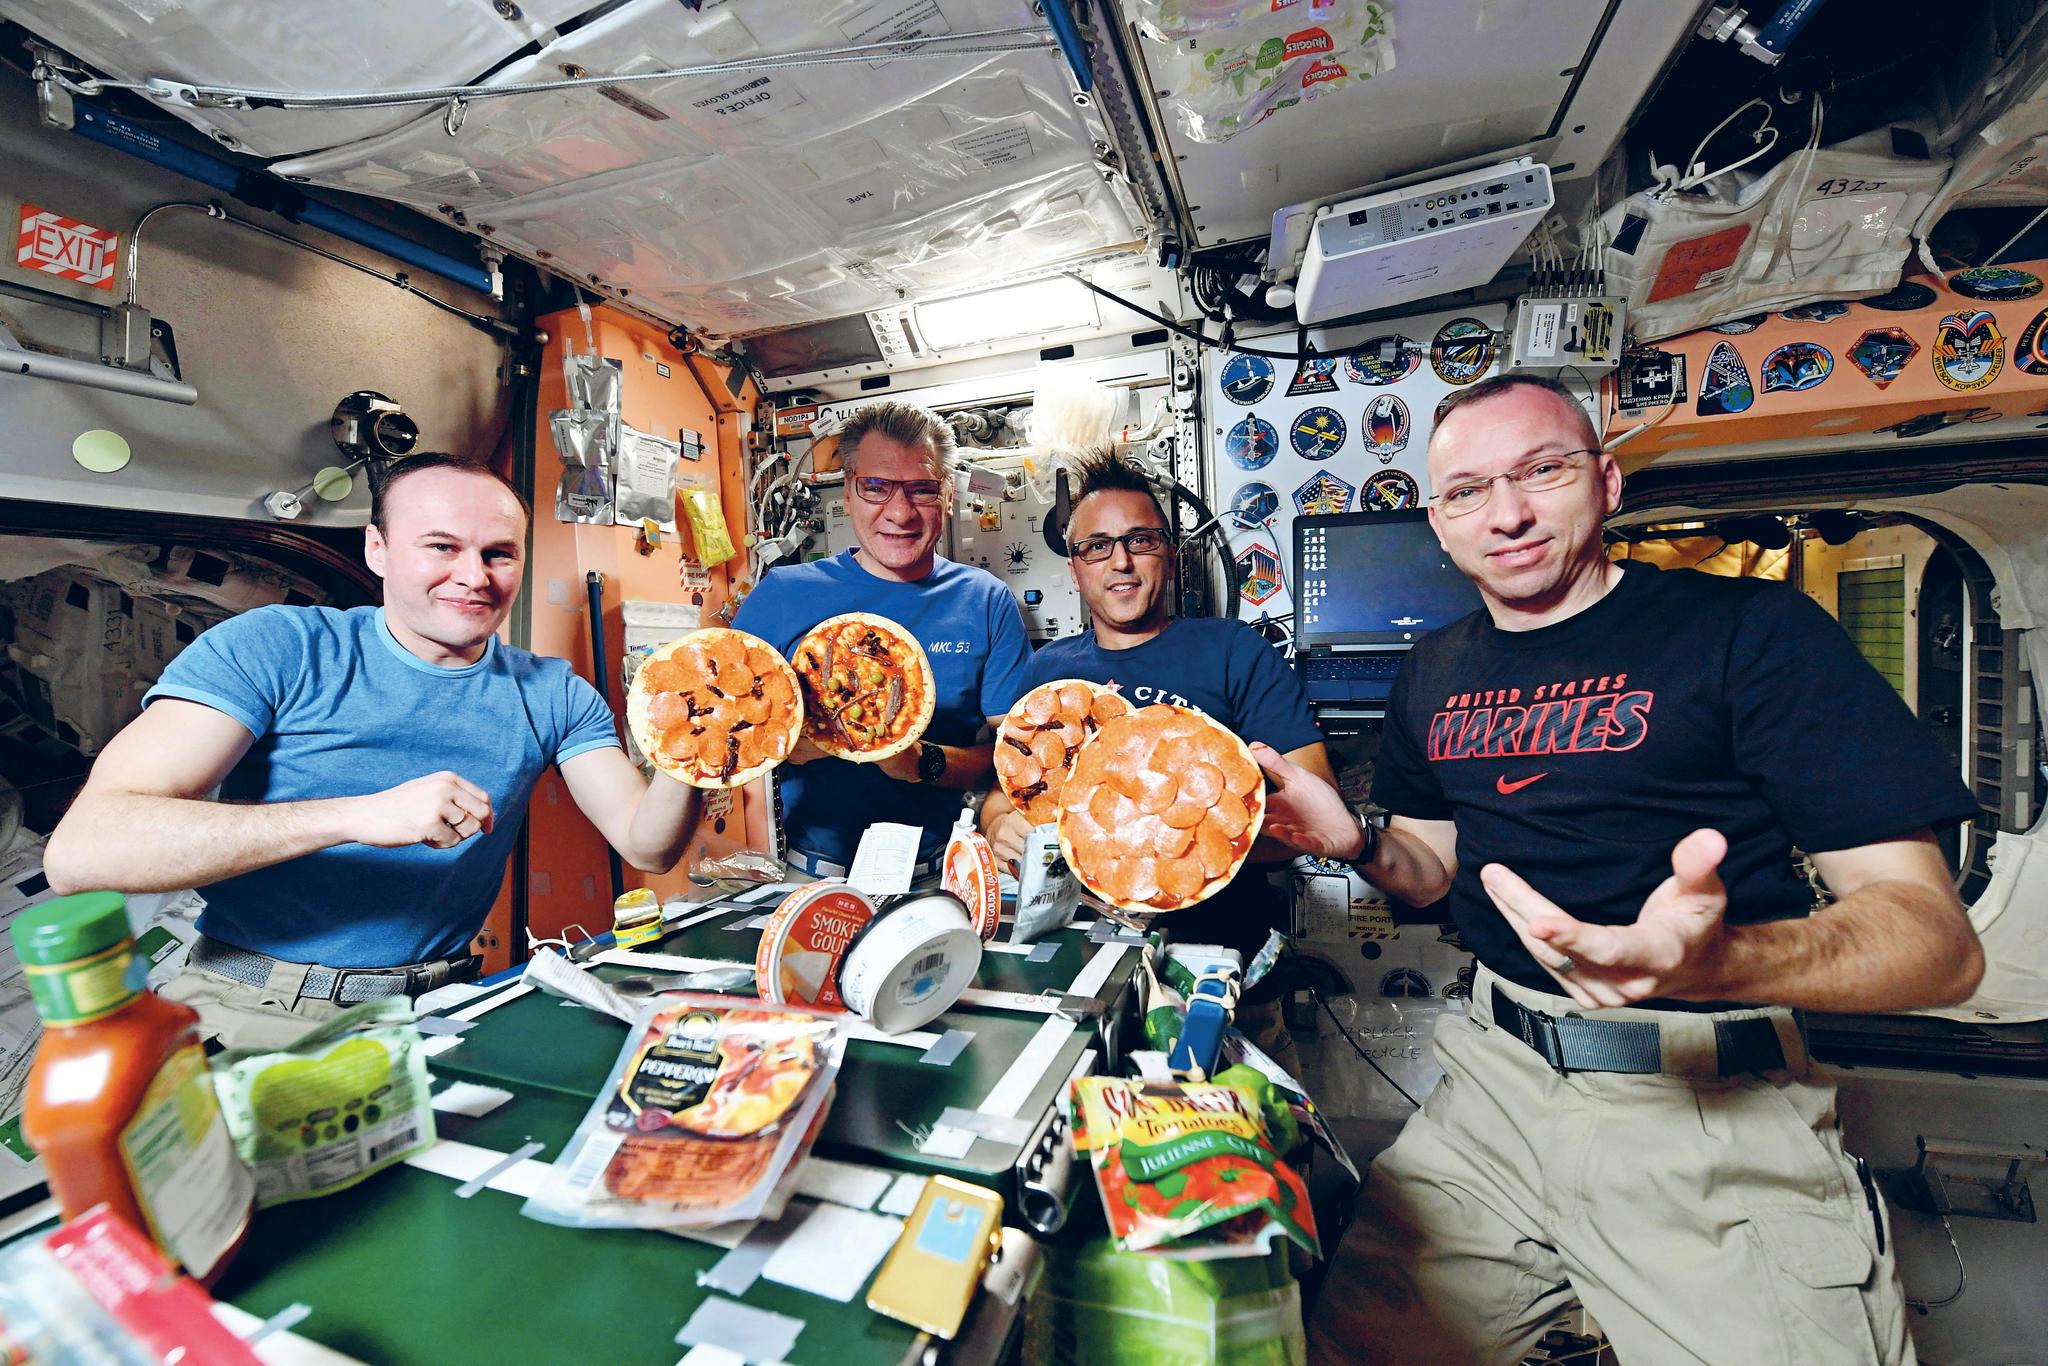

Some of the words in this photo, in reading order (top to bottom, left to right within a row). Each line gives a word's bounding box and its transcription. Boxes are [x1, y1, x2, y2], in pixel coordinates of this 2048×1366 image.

[1286, 37, 1327, 52] HUGGIES
[1305, 67, 1341, 82] HUGGIES
[730, 76, 771, 95] RUBBER
[692, 93, 730, 108] GLOVES
[726, 92, 770, 112] OFFICE
[846, 190, 875, 205] TAPE
[35, 224, 103, 270] EXIT
[2022, 325, 2037, 347] PETTIT
[1935, 356, 1953, 384] WHITSON
[1954, 379, 1987, 390] КОРЗУН
[782, 414, 809, 424] NOD1P4
[1292, 409, 1312, 435] BLOOMFIELD
[955, 641, 971, 654] 53
[1446, 688, 1521, 708] UNITED
[1534, 673, 1627, 700] STATES
[1428, 690, 1654, 761] MARINES
[987, 888, 995, 916] GOUDA
[811, 912, 861, 939] SMOKE
[1138, 1116, 1244, 1137] Tomatoes
[1140, 1135, 1217, 1176] JULIENNE
[1225, 1134, 1262, 1162] CUT
